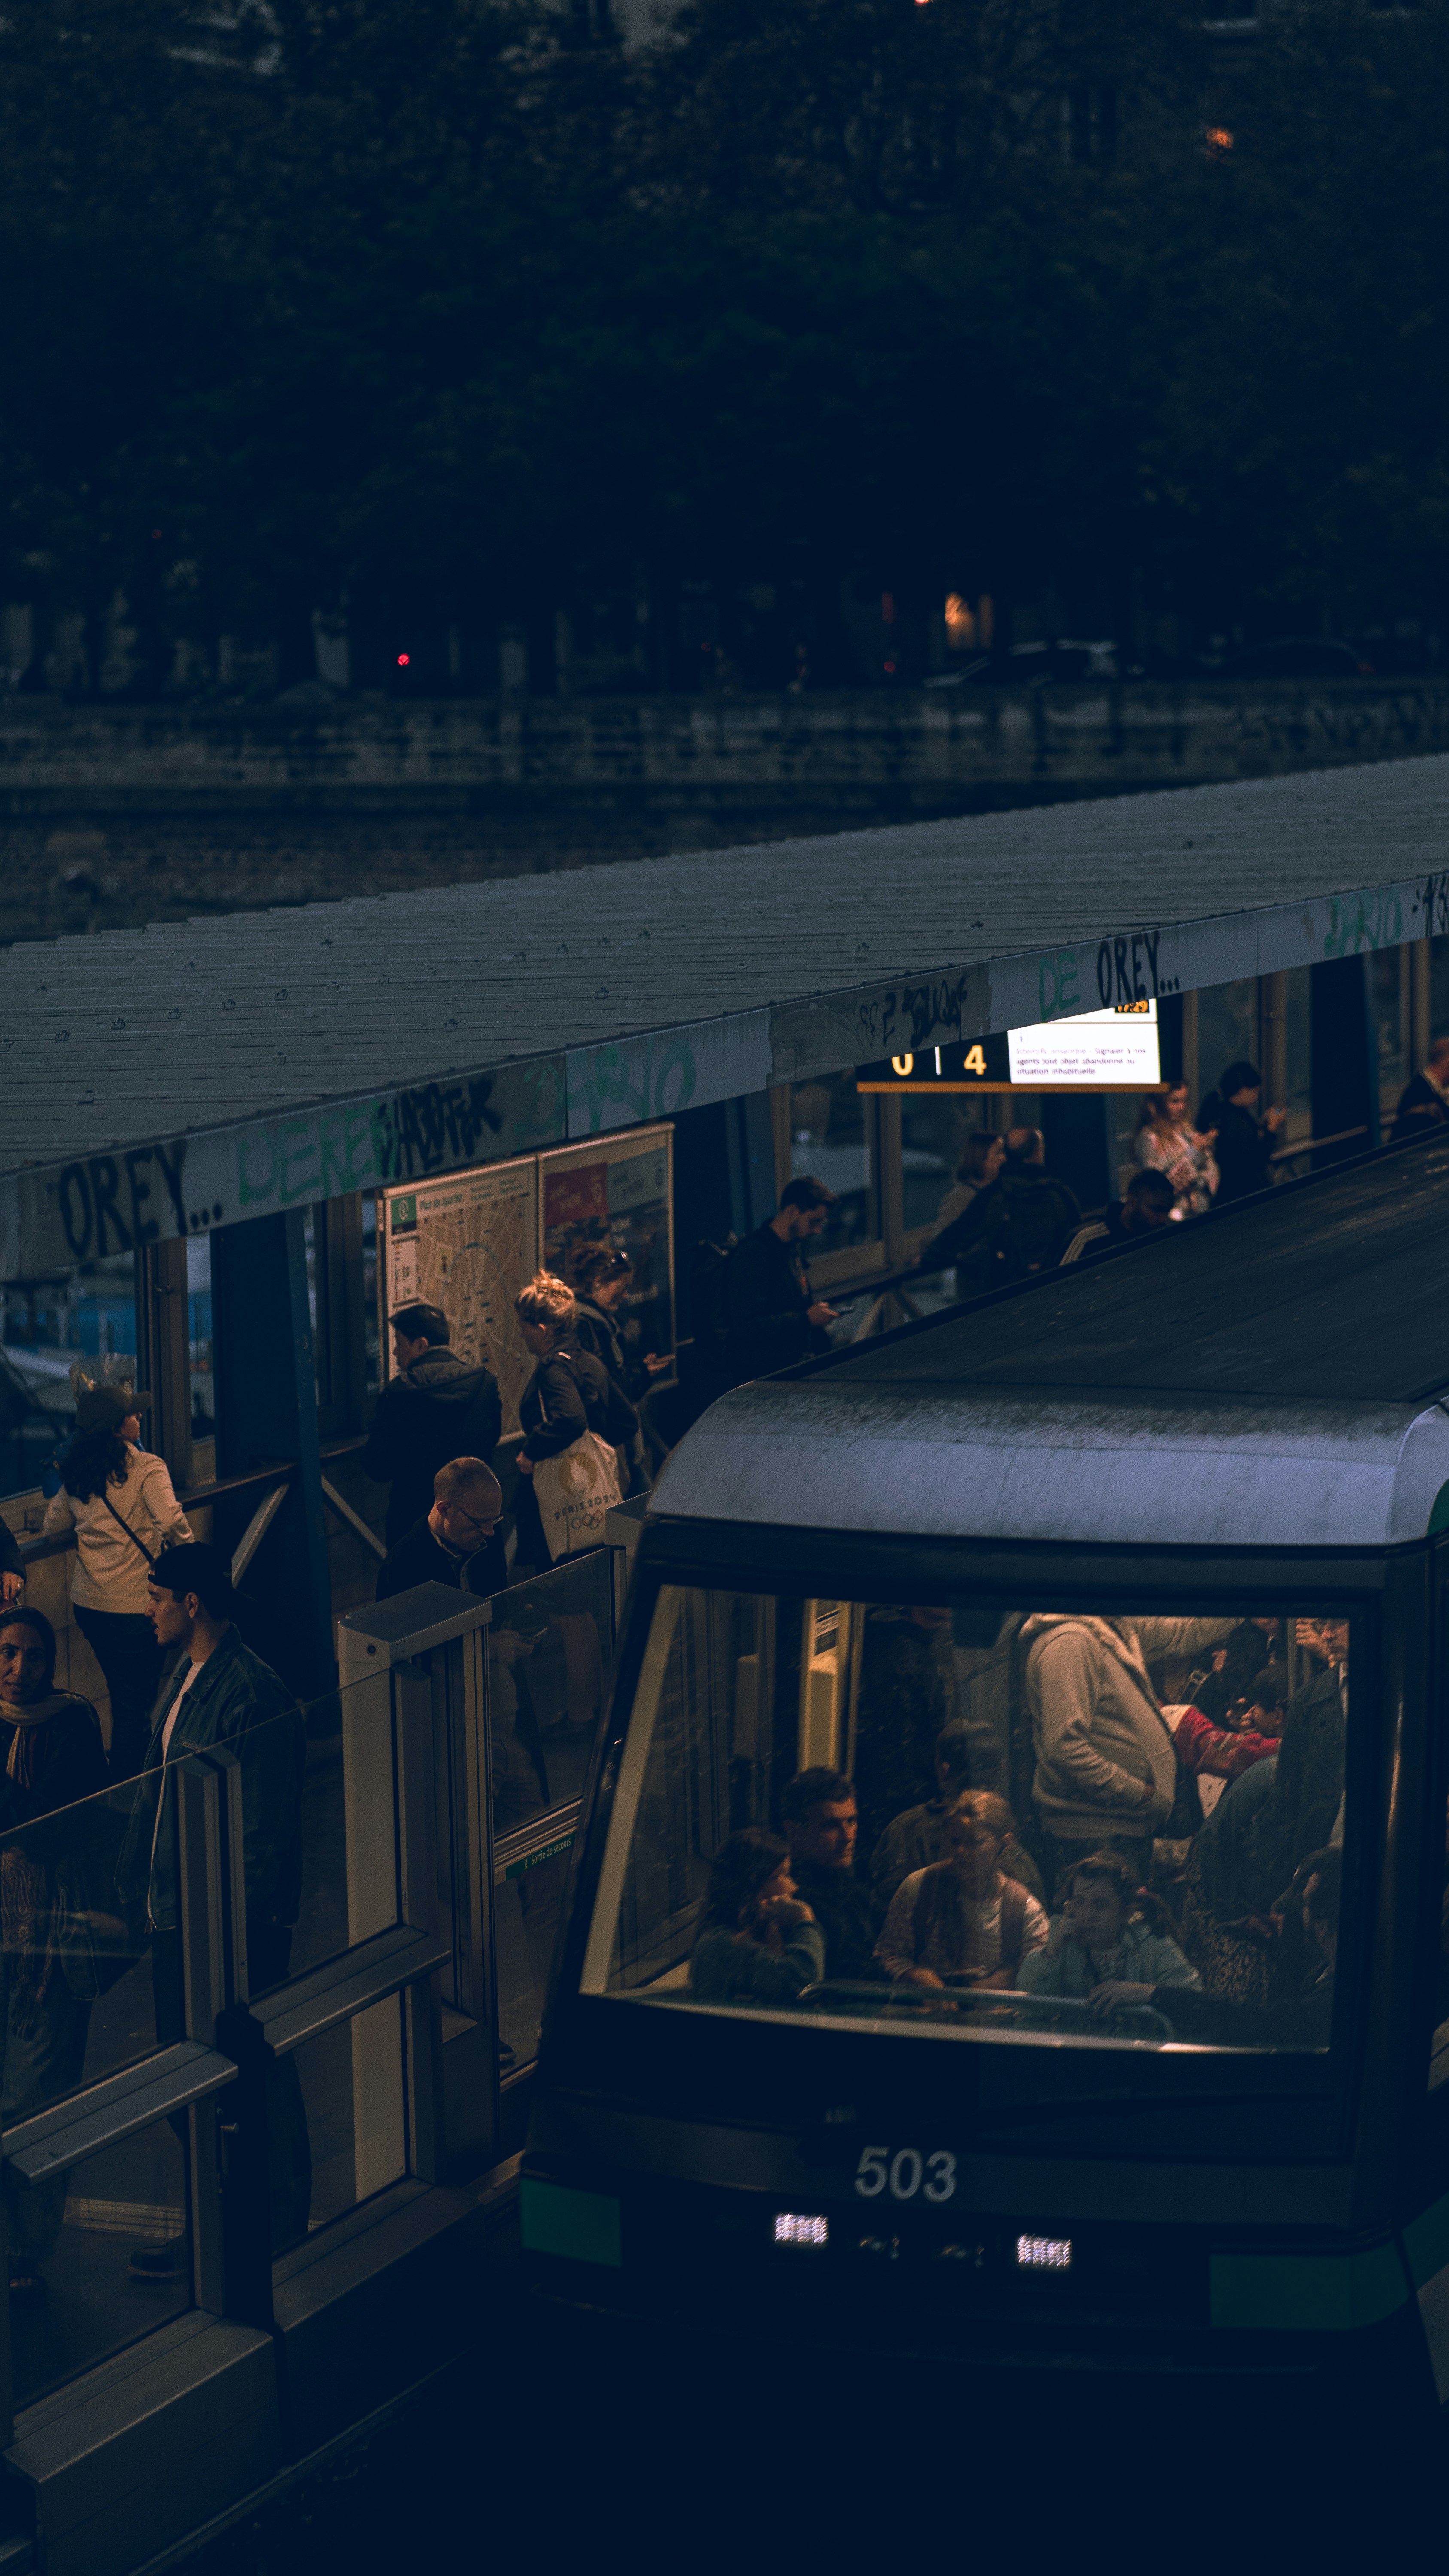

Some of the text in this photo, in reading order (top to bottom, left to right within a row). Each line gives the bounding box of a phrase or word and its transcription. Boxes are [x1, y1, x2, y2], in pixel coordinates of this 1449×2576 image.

[1039, 952, 1080, 1021] DE
[964, 1045, 987, 1075] 4
[555, 1493, 616, 1520] PARIS 2024
[531, 1838, 571, 1865] Sortie de secours
[854, 2145, 957, 2203] 503
